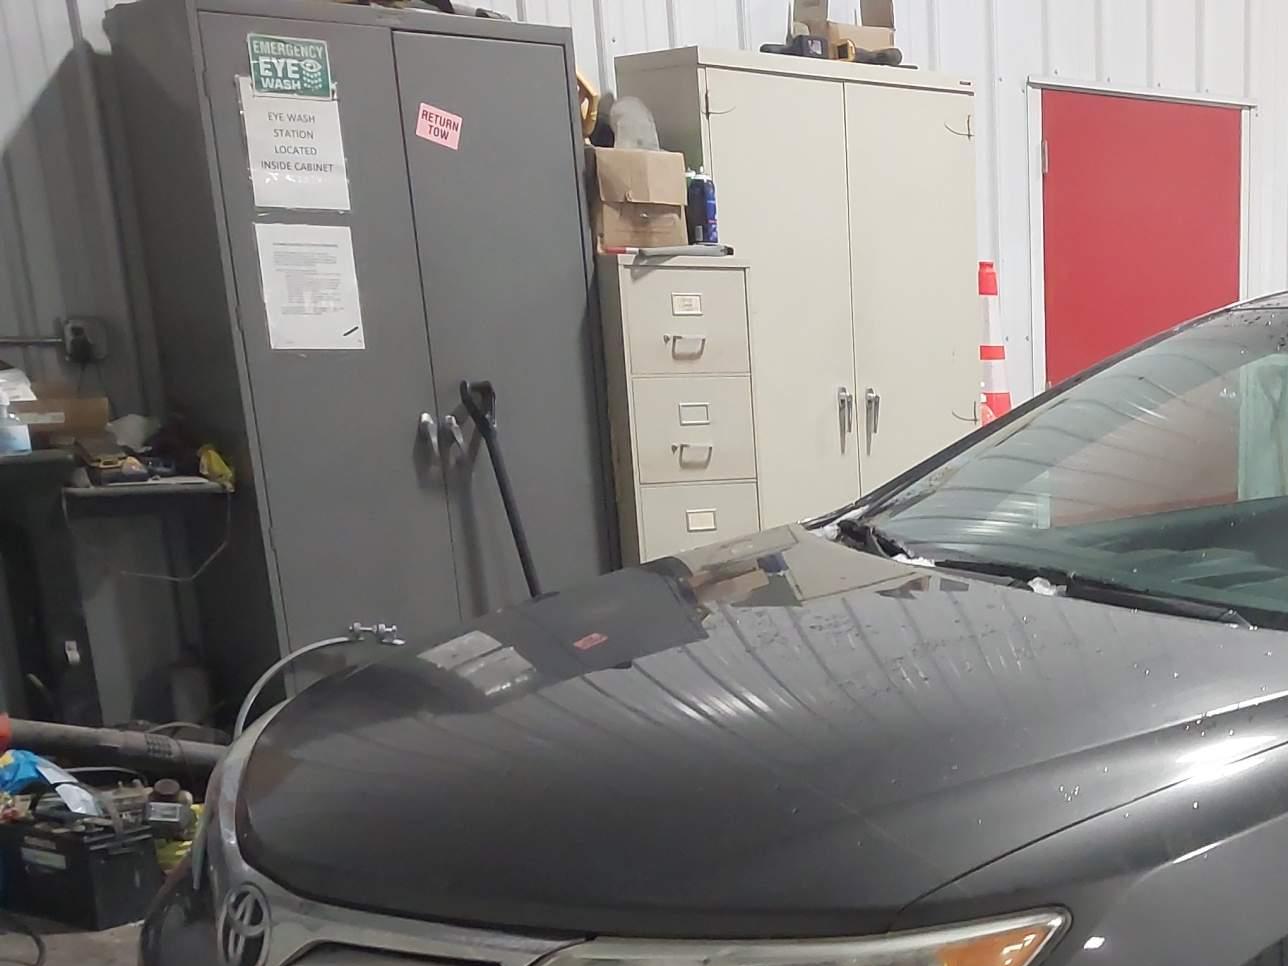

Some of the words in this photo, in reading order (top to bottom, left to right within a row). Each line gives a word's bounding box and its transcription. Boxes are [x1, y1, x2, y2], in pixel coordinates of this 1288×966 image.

[252, 40, 324, 59] EMERGENCY
[259, 56, 300, 79] EYE
[261, 77, 302, 90] WASH
[267, 111, 285, 122] EYE
[286, 112, 316, 124] WASH
[421, 109, 460, 132] RETURN
[273, 128, 314, 140] STATION
[428, 124, 450, 141] TOW
[274, 145, 318, 156] LOCATED
[261, 159, 293, 171] INSIDE
[294, 161, 335, 173] CABINET
